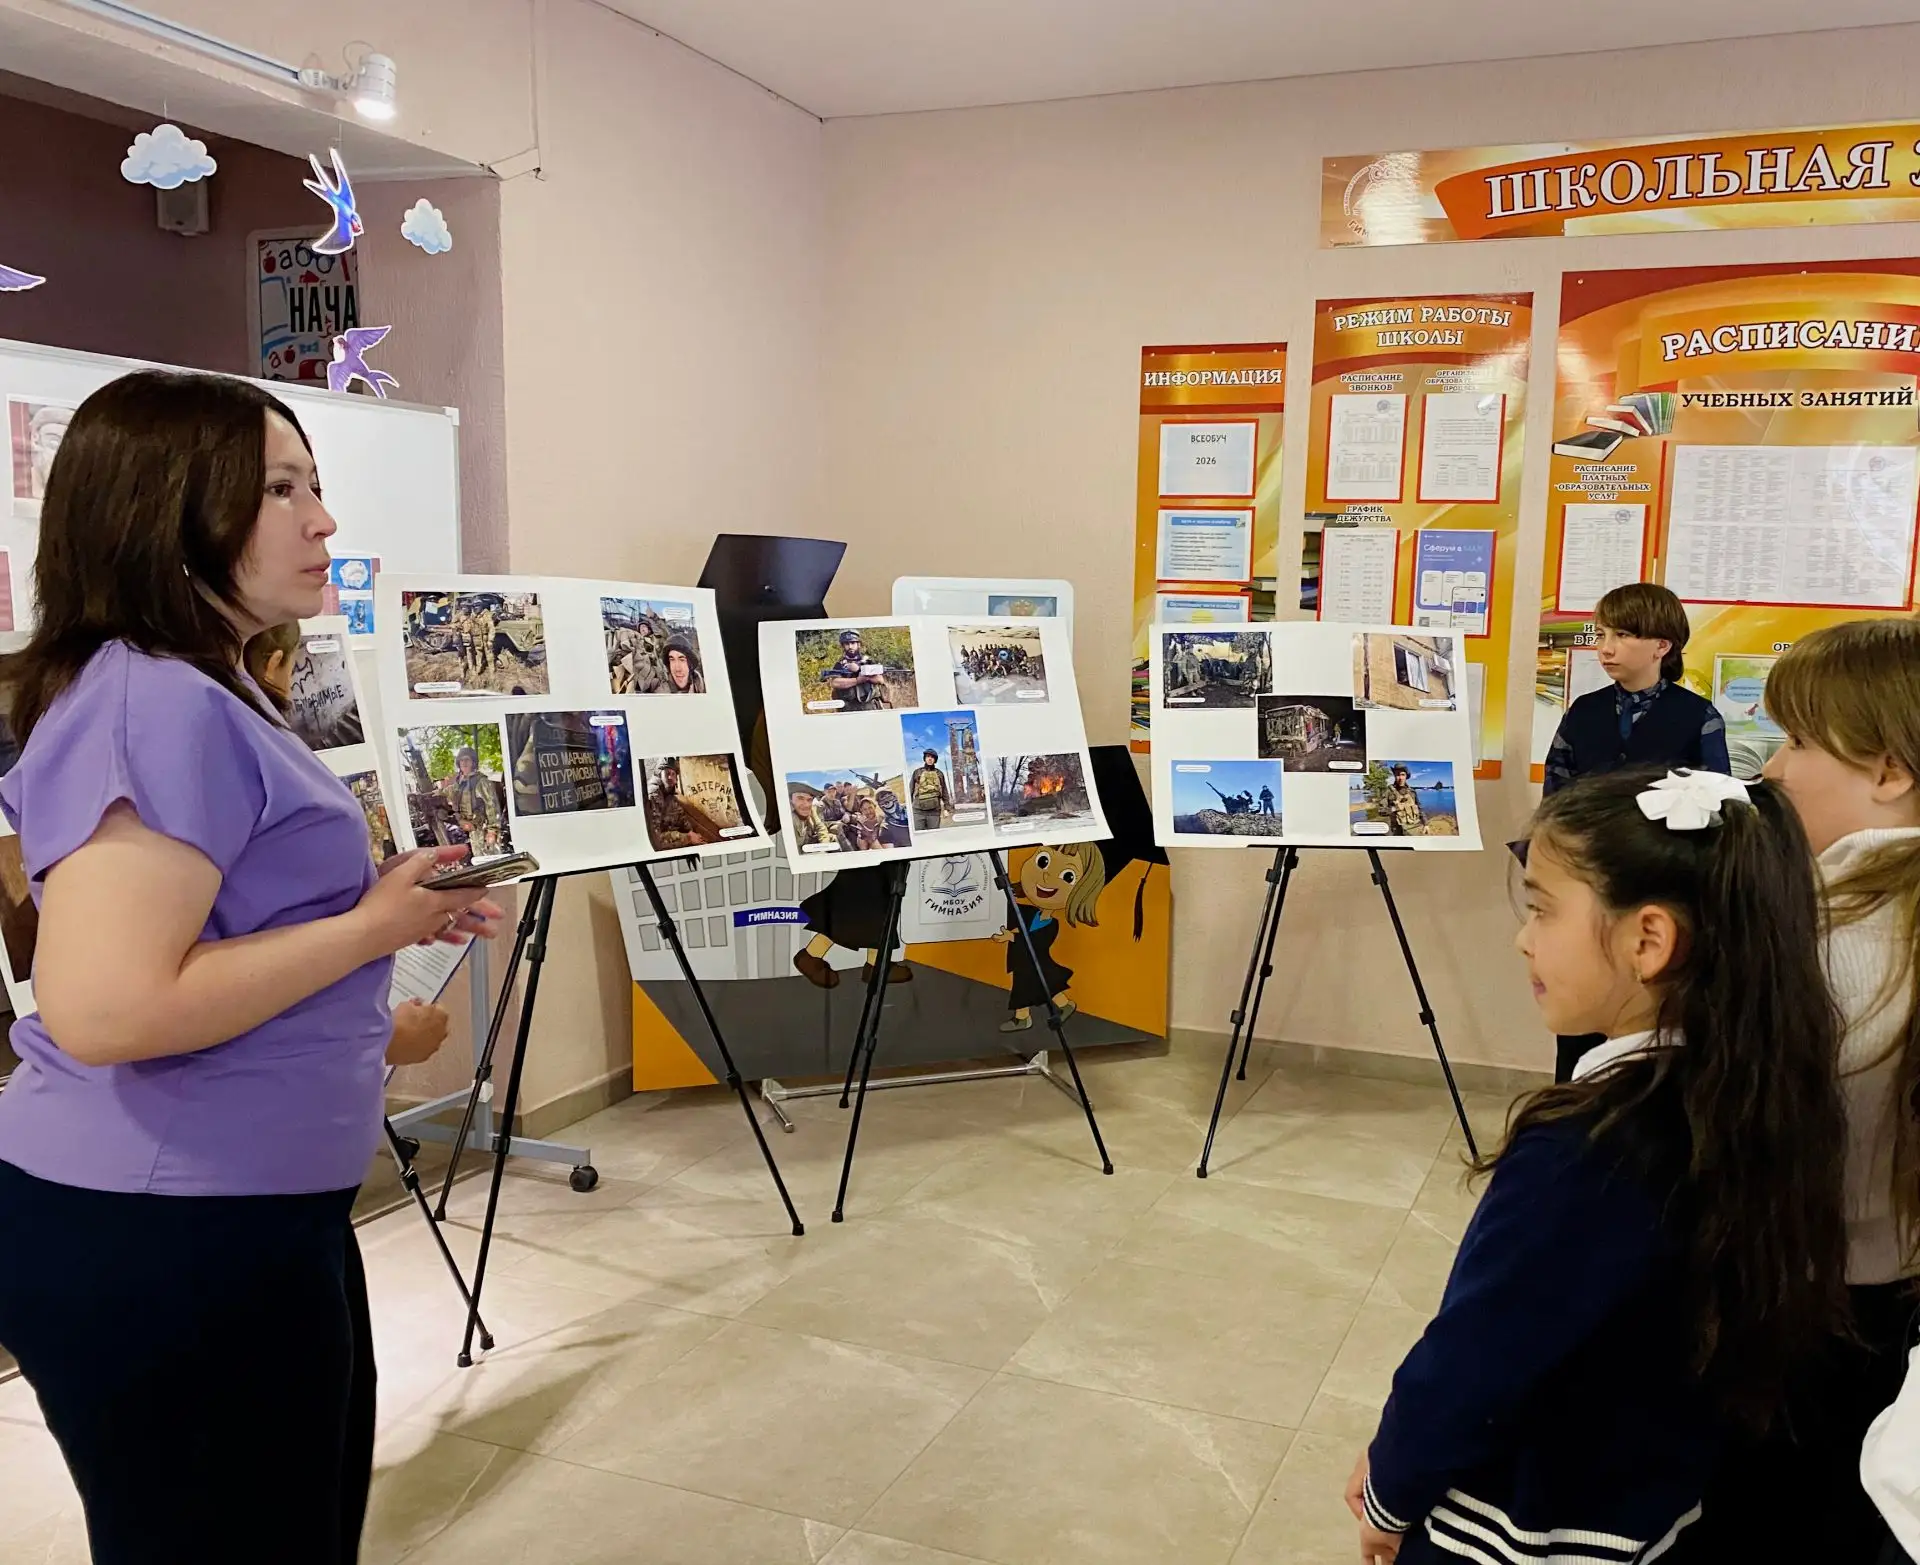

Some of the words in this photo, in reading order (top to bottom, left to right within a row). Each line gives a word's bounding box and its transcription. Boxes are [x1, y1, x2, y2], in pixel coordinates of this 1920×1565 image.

[1484, 141, 1894, 219] ШКОЛЬНАЯ
[1334, 308, 1413, 331] РЕЖИМ
[1420, 307, 1512, 327] РАБОТЫ
[1377, 330, 1463, 347] ШКОЛЫ
[1661, 321, 1920, 361] РАСПИСАНИ
[1143, 369, 1283, 386] ИНФОРМАЦИЯ
[1341, 374, 1403, 382] РАСПИСАНИЕ
[1682, 392, 1793, 407] УЧЕБНЫХ
[1800, 386, 1914, 407] ЗАНЯТИЙ
[1190, 434, 1227, 443] ВСЕОБУЧ
[1196, 457, 1217, 465] 2026
[1336, 515, 1392, 523] ДЕЖУРСТВА
[691, 780, 732, 796] ВЕТЕРАН
[925, 894, 984, 916] ГИМНАЗИЯ
[748, 911, 799, 923] ГИМНАЗИЯ
